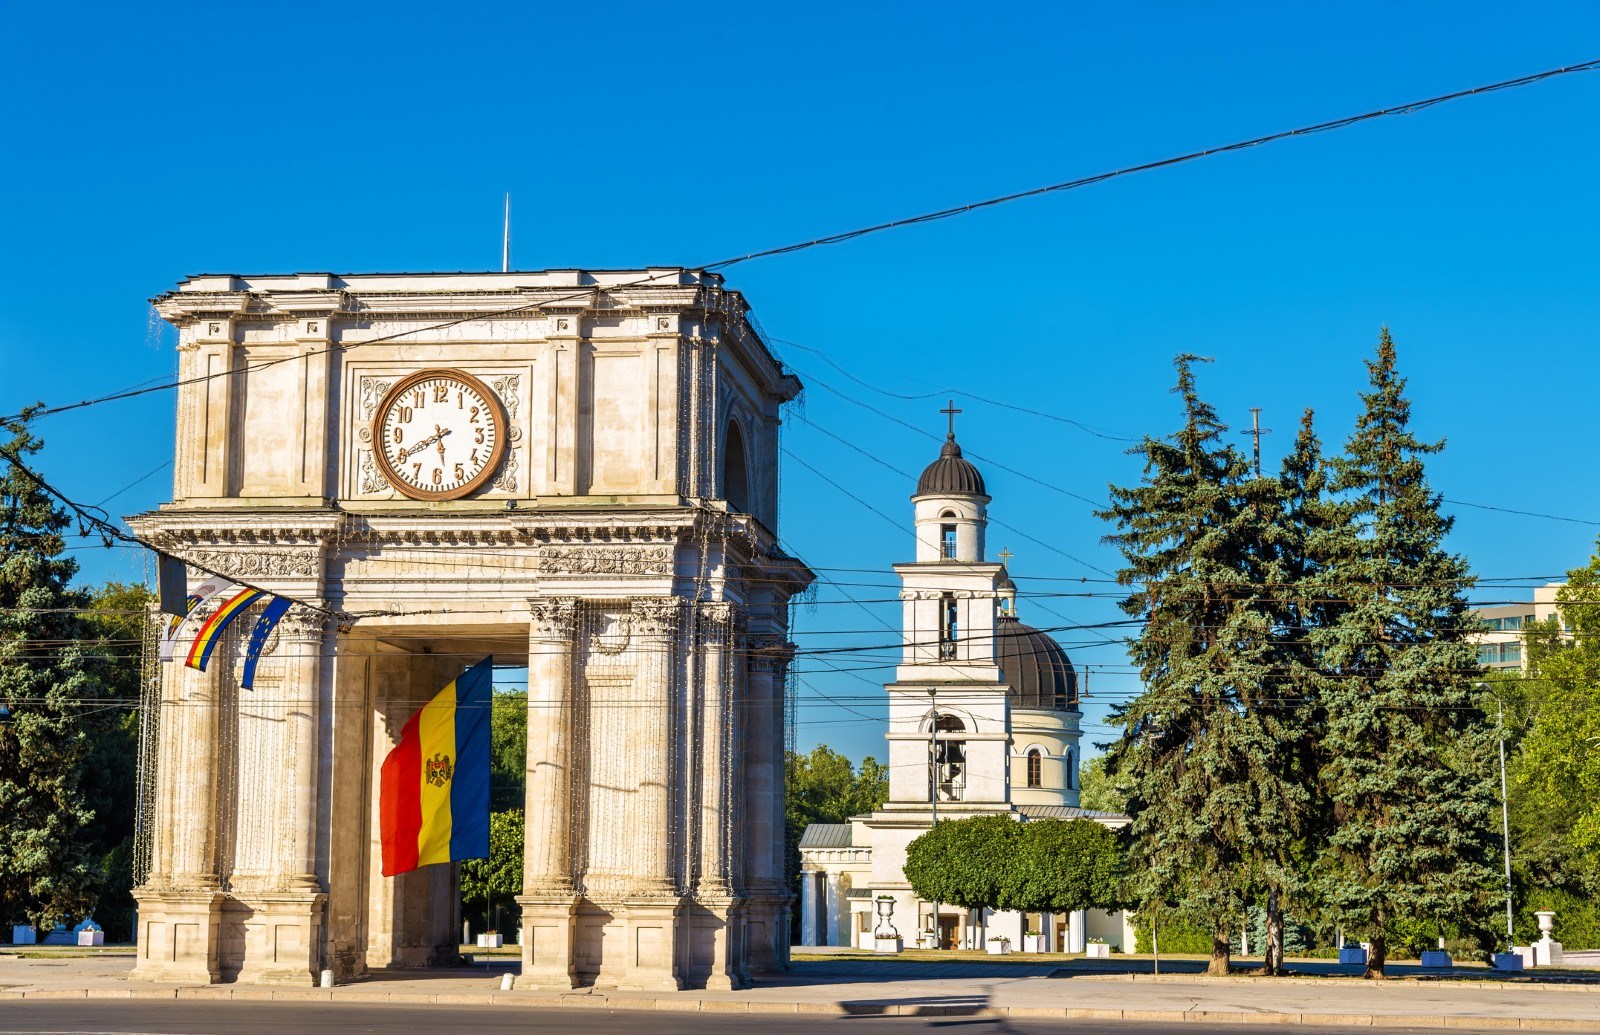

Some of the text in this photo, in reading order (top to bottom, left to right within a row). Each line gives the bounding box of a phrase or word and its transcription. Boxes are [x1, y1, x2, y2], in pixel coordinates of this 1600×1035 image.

[413, 391, 425, 408] 11
[433, 386, 448, 403] 12
[457, 392, 463, 409] 1
[398, 406, 413, 423] 10
[470, 406, 479, 423] 2
[394, 427, 403, 444] 9
[475, 427, 484, 444] 3
[398, 448, 407, 464] 8
[470, 448, 478, 465] 4
[413, 463, 422, 480] 7
[432, 468, 442, 485] 6
[454, 463, 464, 480] 5
